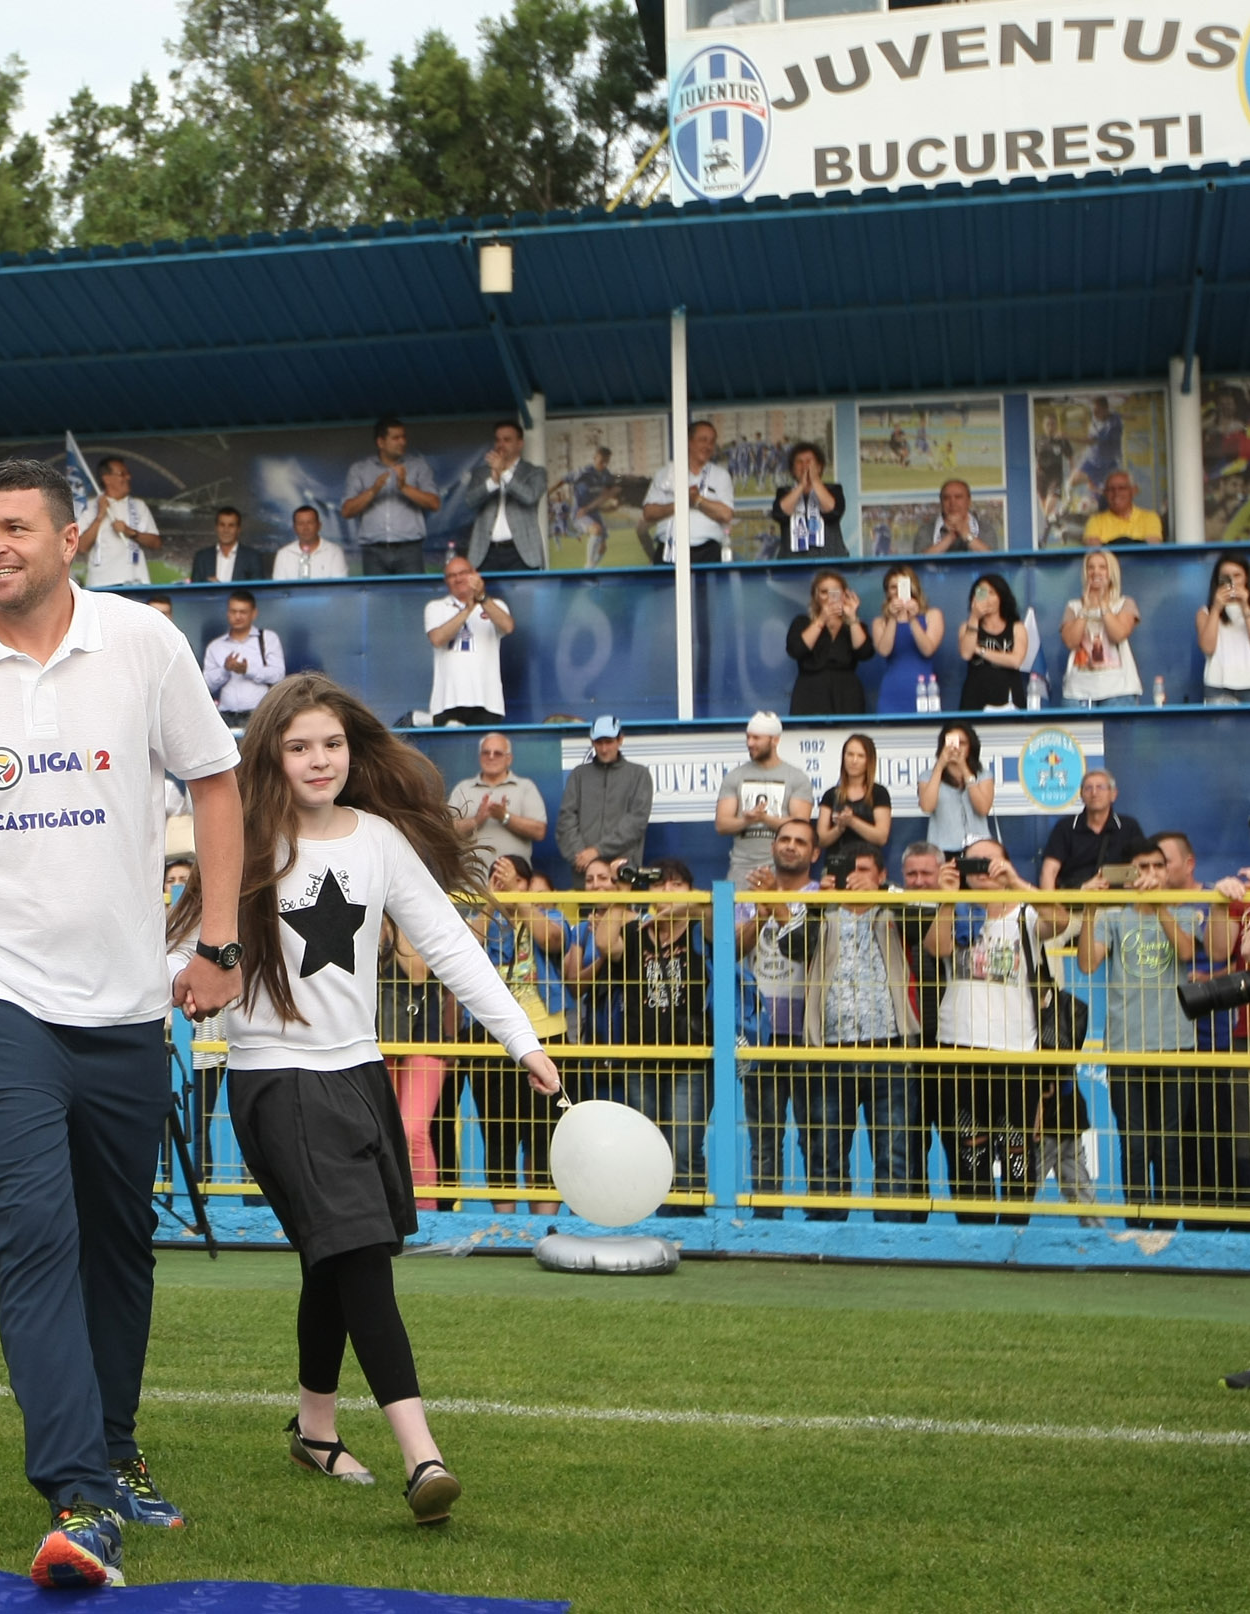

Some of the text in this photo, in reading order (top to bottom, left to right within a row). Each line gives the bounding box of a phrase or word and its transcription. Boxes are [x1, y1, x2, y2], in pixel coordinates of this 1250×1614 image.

[771, 18, 1241, 111] JUVENTUS
[680, 82, 759, 110] JUVENTUS
[814, 114, 1203, 188] BUCURESTI
[799, 740, 826, 753] 1992
[28, 750, 111, 774] LIGA 2
[806, 759, 820, 772] 25
[279, 898, 297, 911] Be
